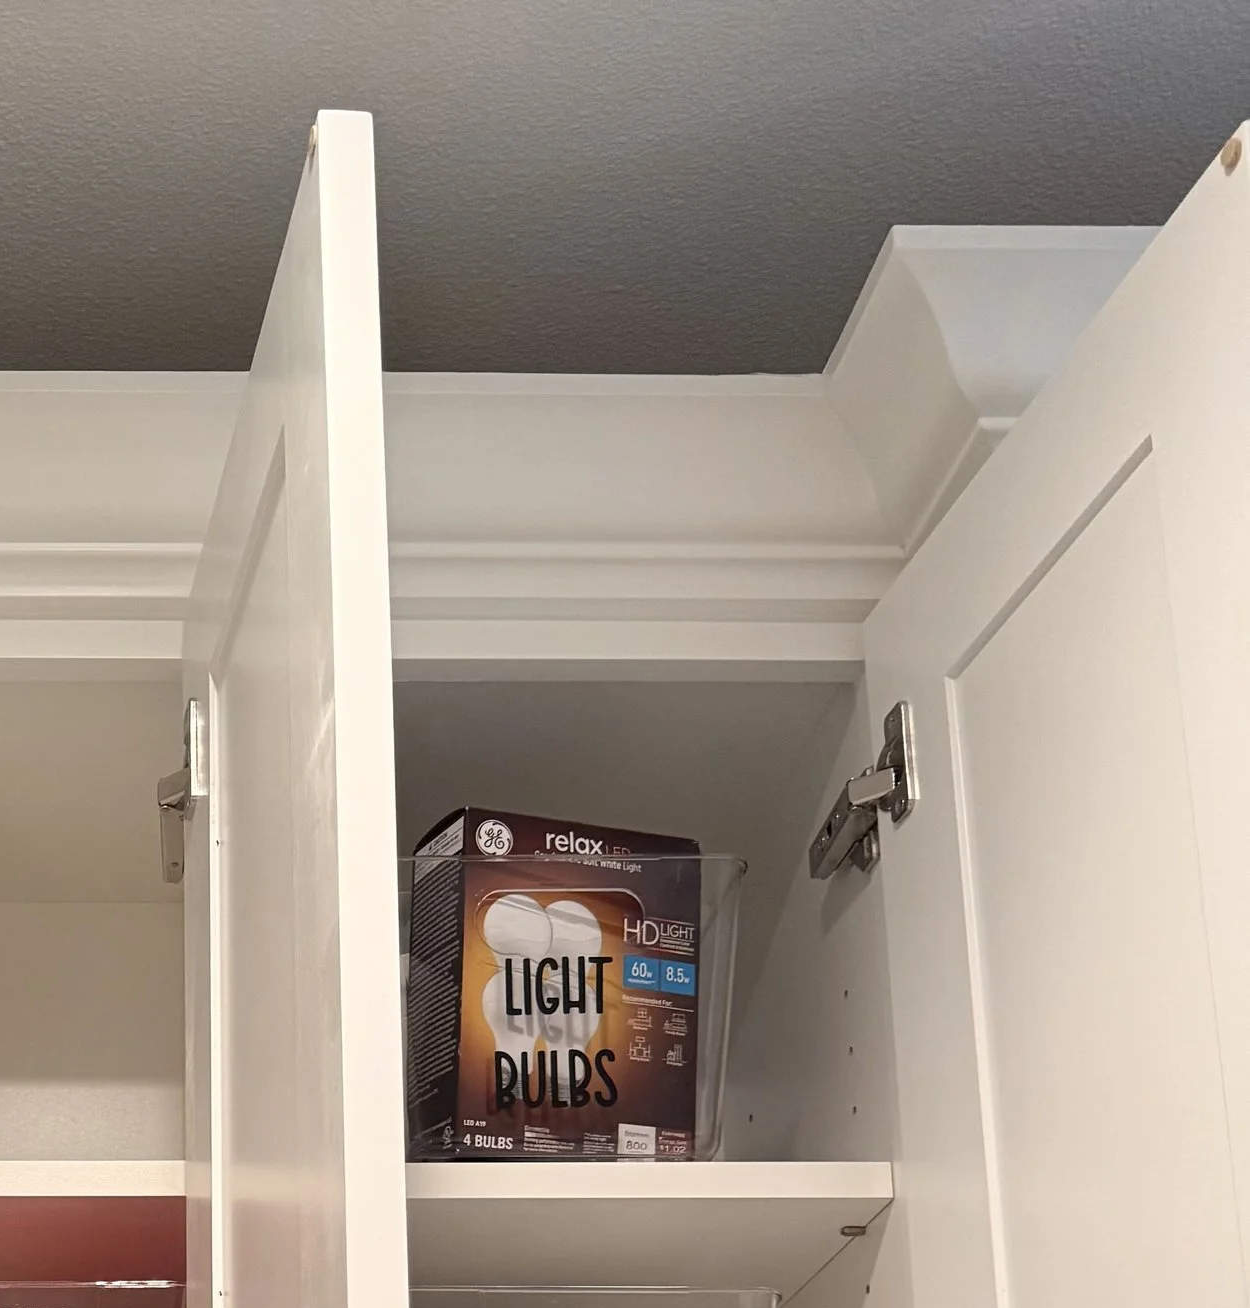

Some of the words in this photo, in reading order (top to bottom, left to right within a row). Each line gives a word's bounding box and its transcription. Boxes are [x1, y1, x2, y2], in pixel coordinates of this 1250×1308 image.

[546, 831, 603, 855] relax
[623, 861, 642, 873] Light
[623, 918, 659, 945] HD
[660, 923, 695, 940] LIGHT
[504, 956, 613, 1016] LIGHT
[495, 1048, 618, 1109] BULBS
[463, 1133, 472, 1146] 4
[474, 1134, 514, 1150] BULBS
